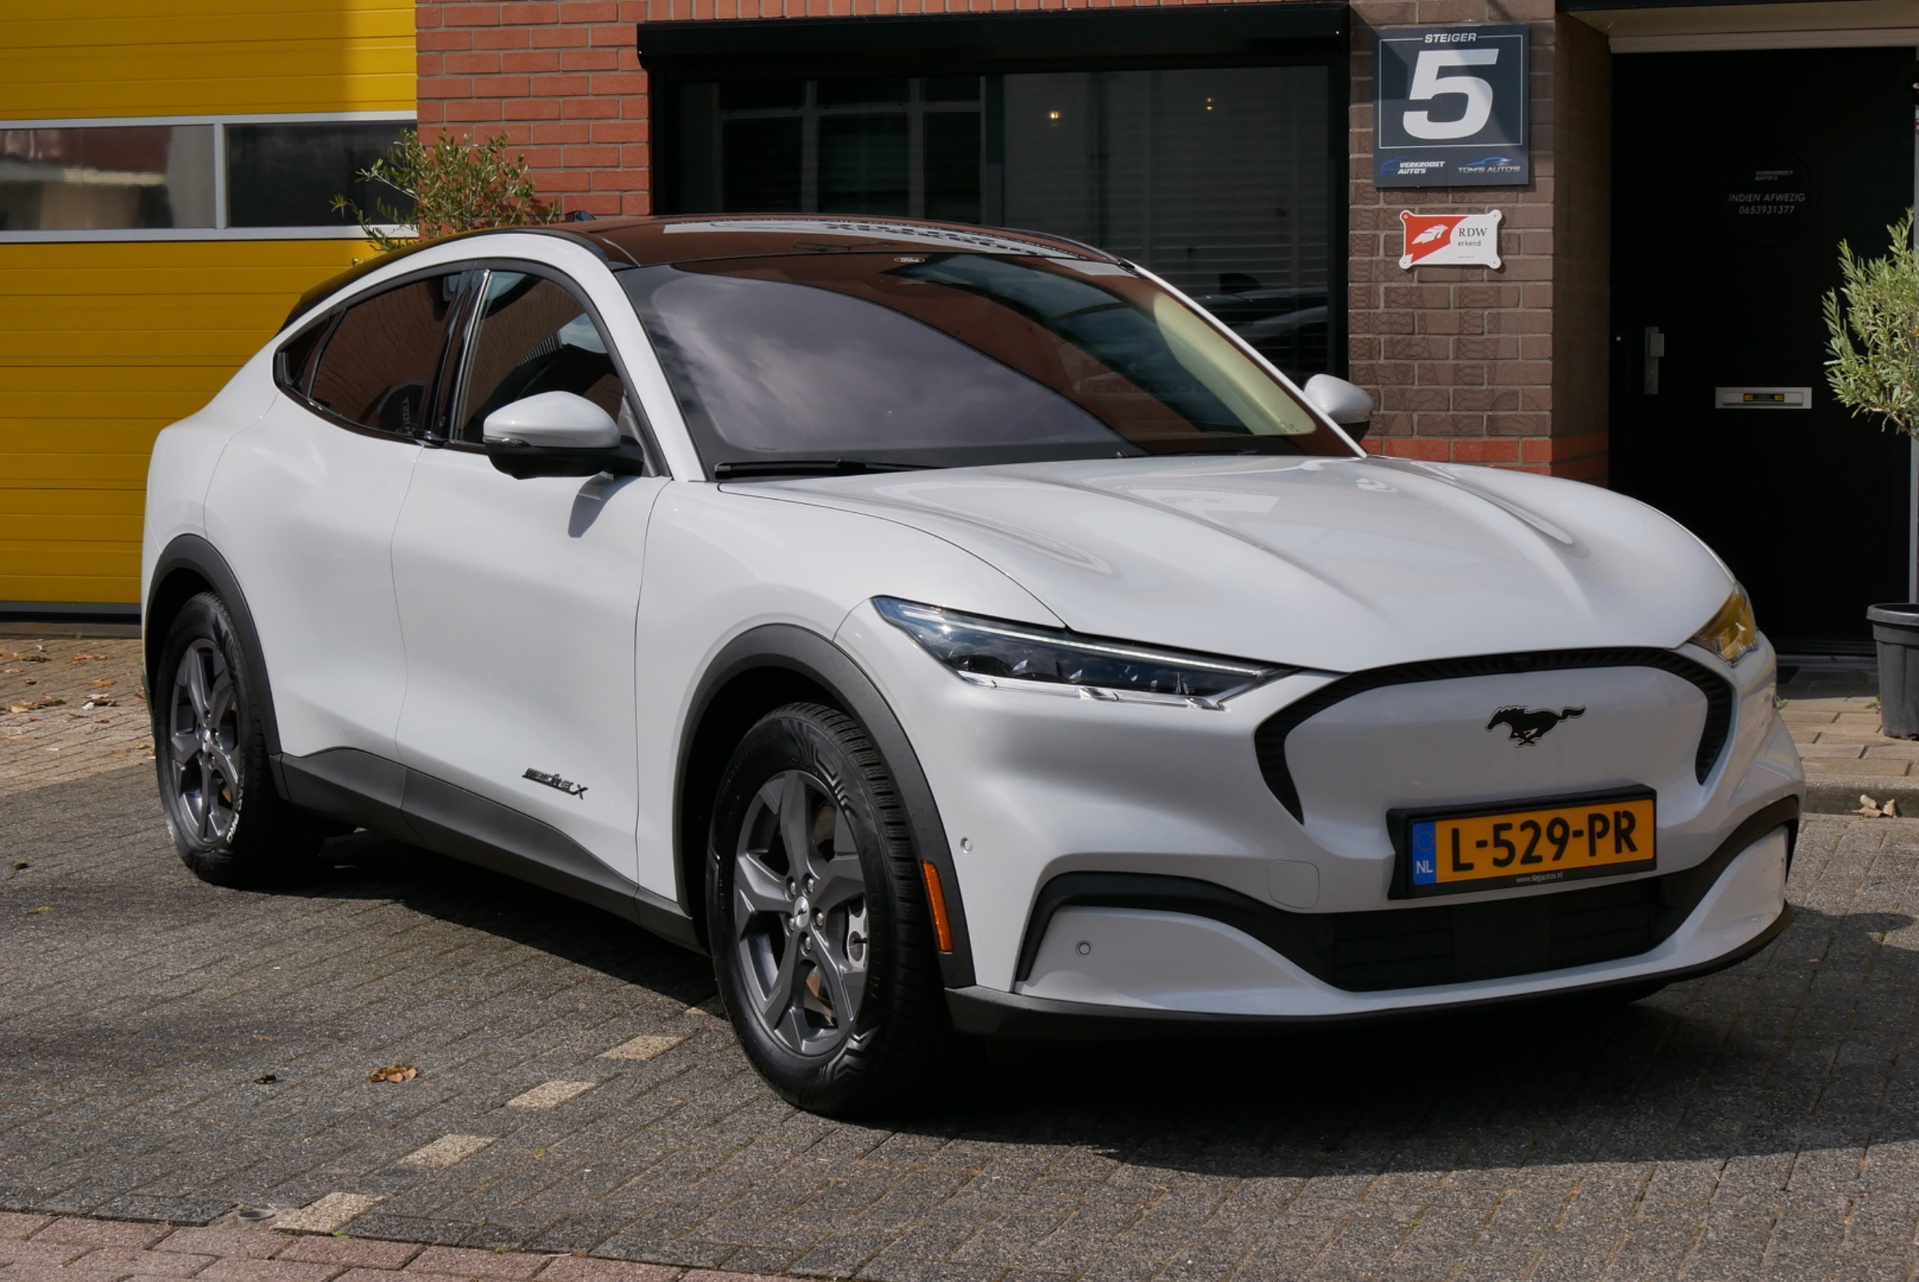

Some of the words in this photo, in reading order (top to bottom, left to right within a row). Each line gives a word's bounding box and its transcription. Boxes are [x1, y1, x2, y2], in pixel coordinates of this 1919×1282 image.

[1424, 33, 1477, 43] STEIGER
[1402, 48, 1499, 140] 5
[1399, 161, 1446, 169] VERKROOST
[1397, 167, 1427, 175] AUTO'S
[1728, 193, 1762, 203] INDIEN
[1763, 193, 1806, 202] AFWEZIG
[1739, 205, 1796, 215] 0653931377
[1458, 227, 1488, 237] RDW
[1451, 810, 1638, 873] L-529-PR
[1416, 859, 1434, 874] NL
